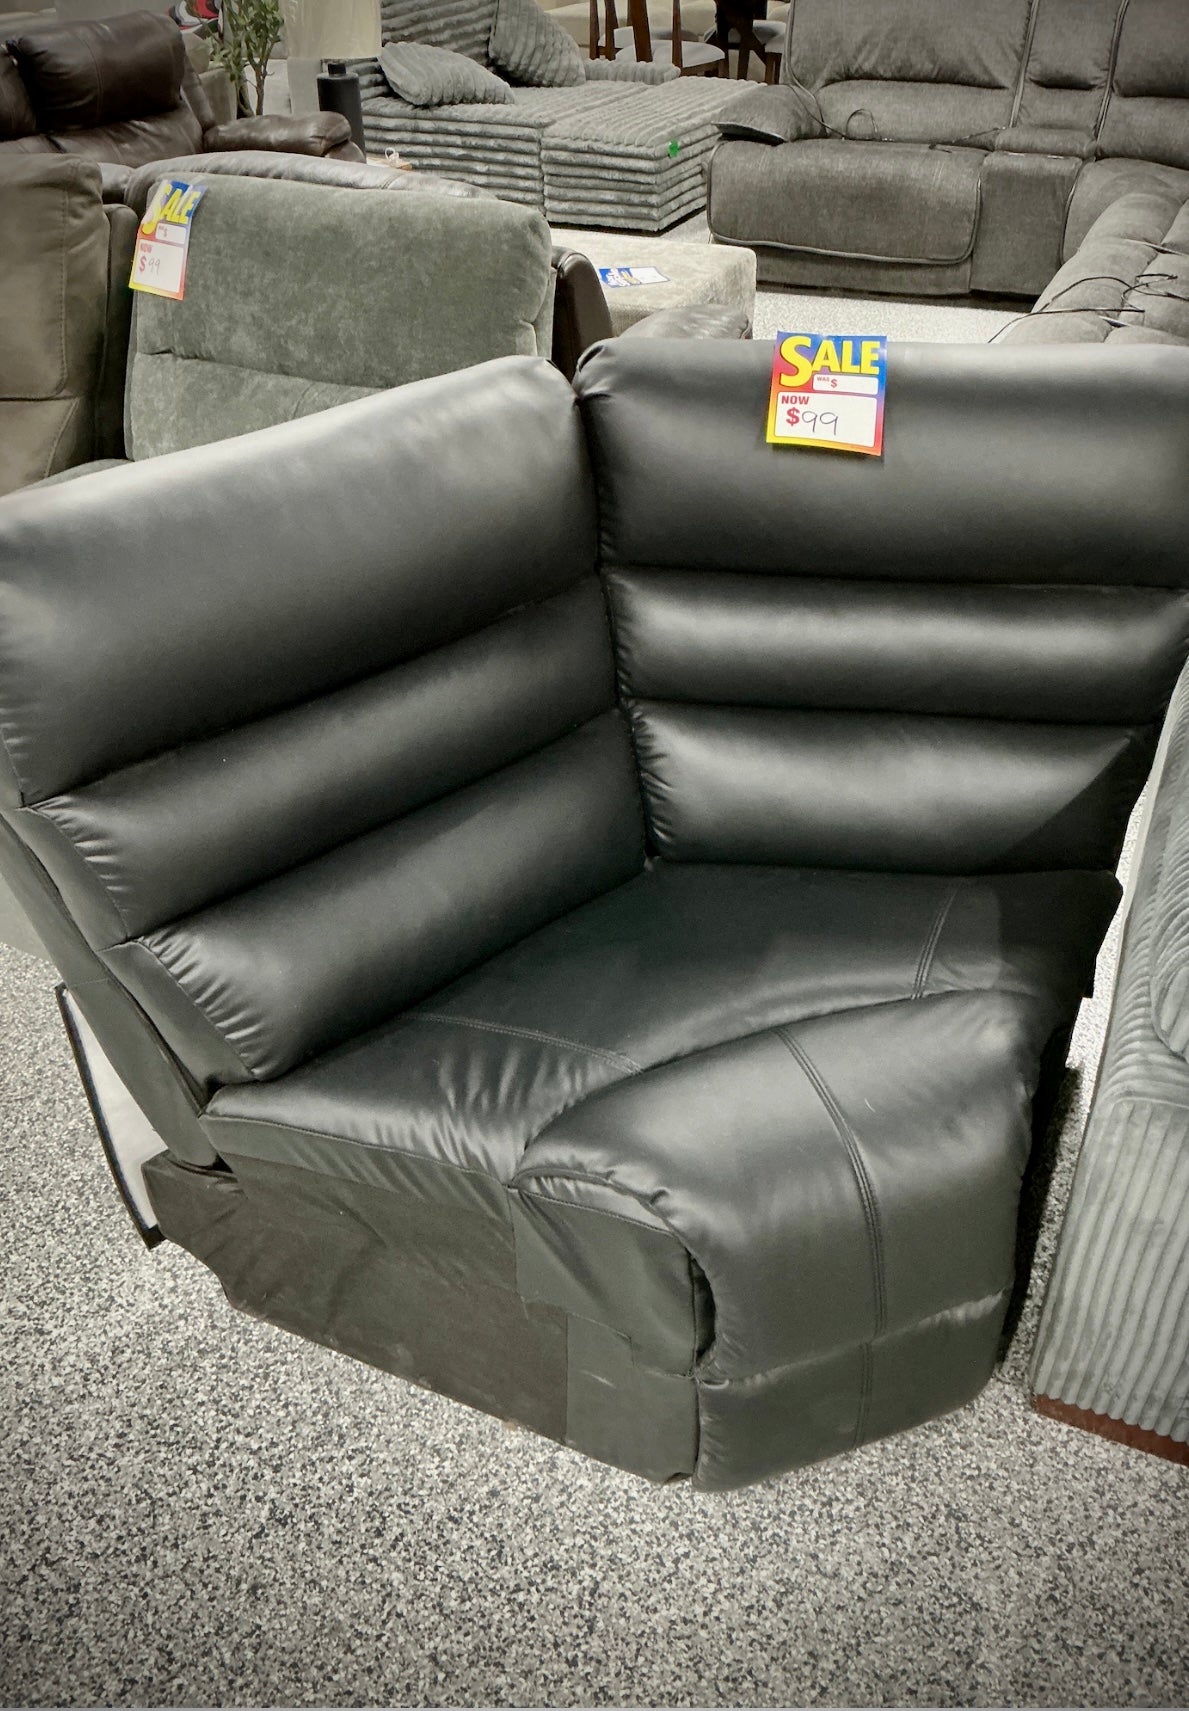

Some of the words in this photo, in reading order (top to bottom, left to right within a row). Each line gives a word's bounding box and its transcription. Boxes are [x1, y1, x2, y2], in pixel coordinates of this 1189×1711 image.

[141, 183, 201, 235] SALE
[780, 335, 880, 387] SALE
[781, 395, 809, 405] NOW
